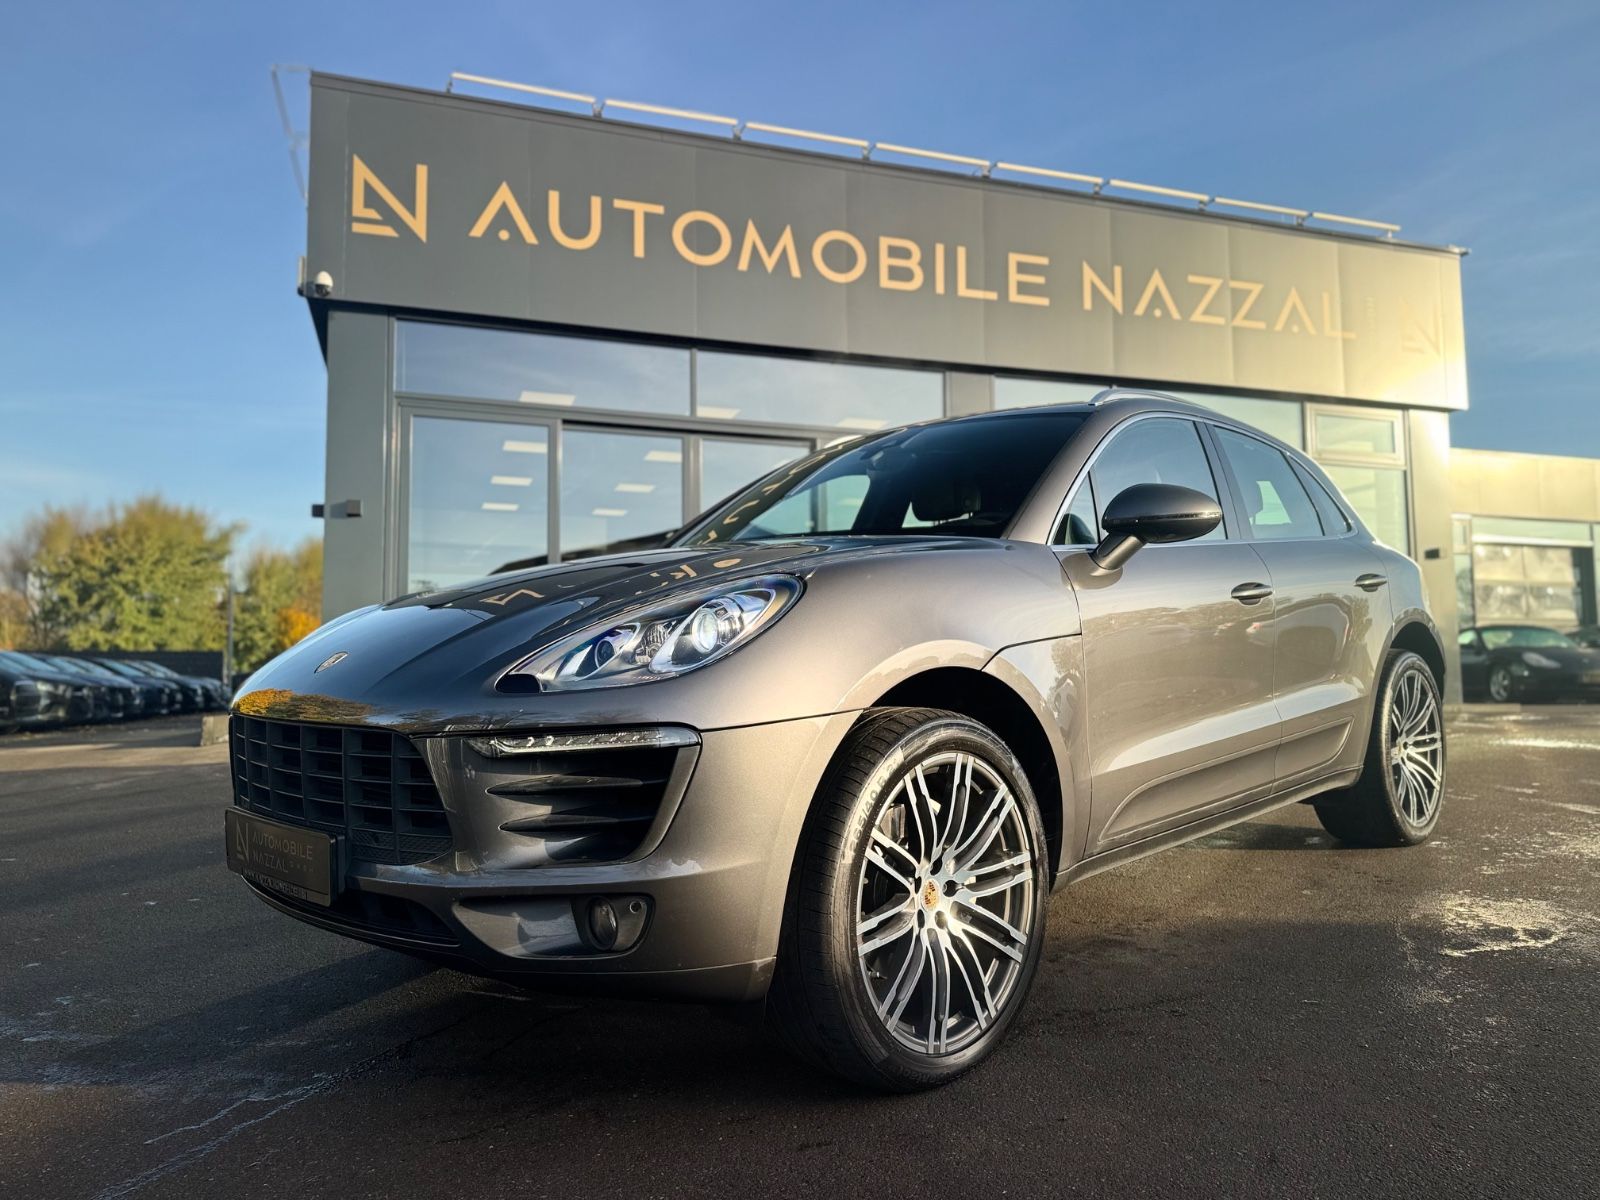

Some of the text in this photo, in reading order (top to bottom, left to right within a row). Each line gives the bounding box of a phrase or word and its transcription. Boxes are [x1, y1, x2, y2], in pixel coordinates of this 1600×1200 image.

[468, 180, 1051, 308] AUTOMOBILE
[1081, 258, 1357, 341] NAZZAL
[252, 831, 313, 860] AUTOMOBILE
[253, 851, 288, 873] NAZZAL
